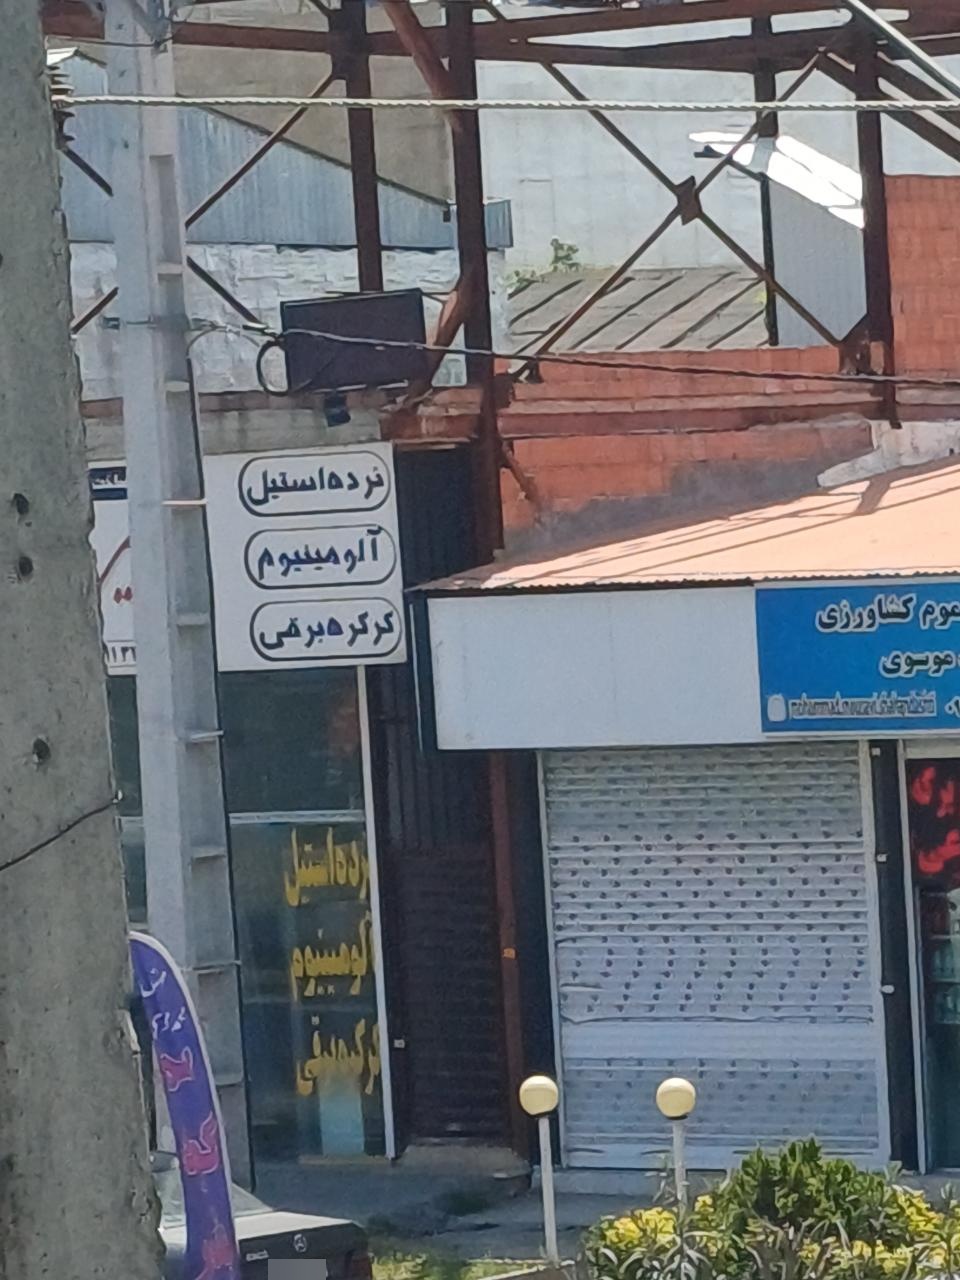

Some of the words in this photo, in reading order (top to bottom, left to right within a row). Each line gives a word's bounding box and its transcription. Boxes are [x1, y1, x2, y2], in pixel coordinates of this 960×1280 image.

[257, 525, 385, 581] آلومینیوم
[816, 593, 915, 632] کشاورزی
[881, 648, 954, 677] موسوی
